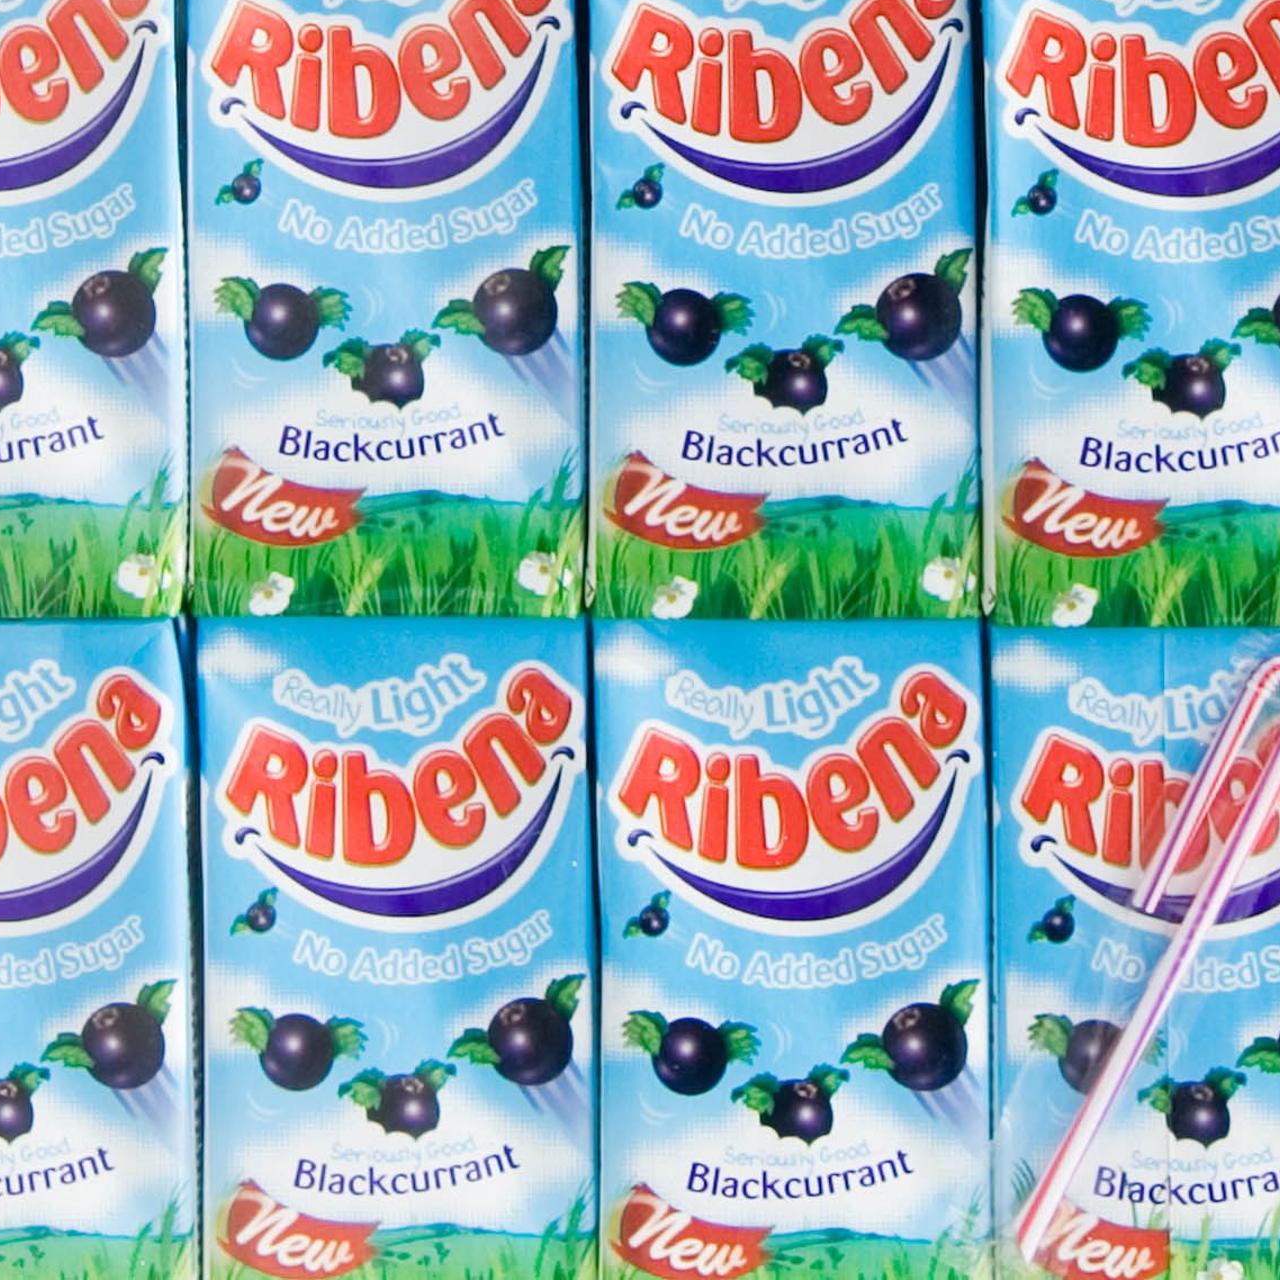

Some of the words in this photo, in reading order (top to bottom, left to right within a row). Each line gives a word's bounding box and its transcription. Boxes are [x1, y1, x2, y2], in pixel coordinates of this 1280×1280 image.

[54, 183, 135, 248] Sugar
[684, 210, 731, 251] No
[740, 225, 848, 257] Added
[857, 186, 941, 249] Sugar
[278, 412, 506, 464] Blackcurrant
[682, 420, 908, 467] Blackcurrant
[222, 475, 339, 536] New
[625, 476, 741, 539] New
[1023, 484, 1141, 549] New
[673, 680, 754, 729] Really
[764, 660, 873, 730] Light
[225, 666, 572, 868] Ribena
[618, 671, 967, 873] Ribena
[294, 1144, 521, 1197] Blackcurrant
[686, 1147, 914, 1201] Blackcurrant
[234, 1199, 353, 1274] New
